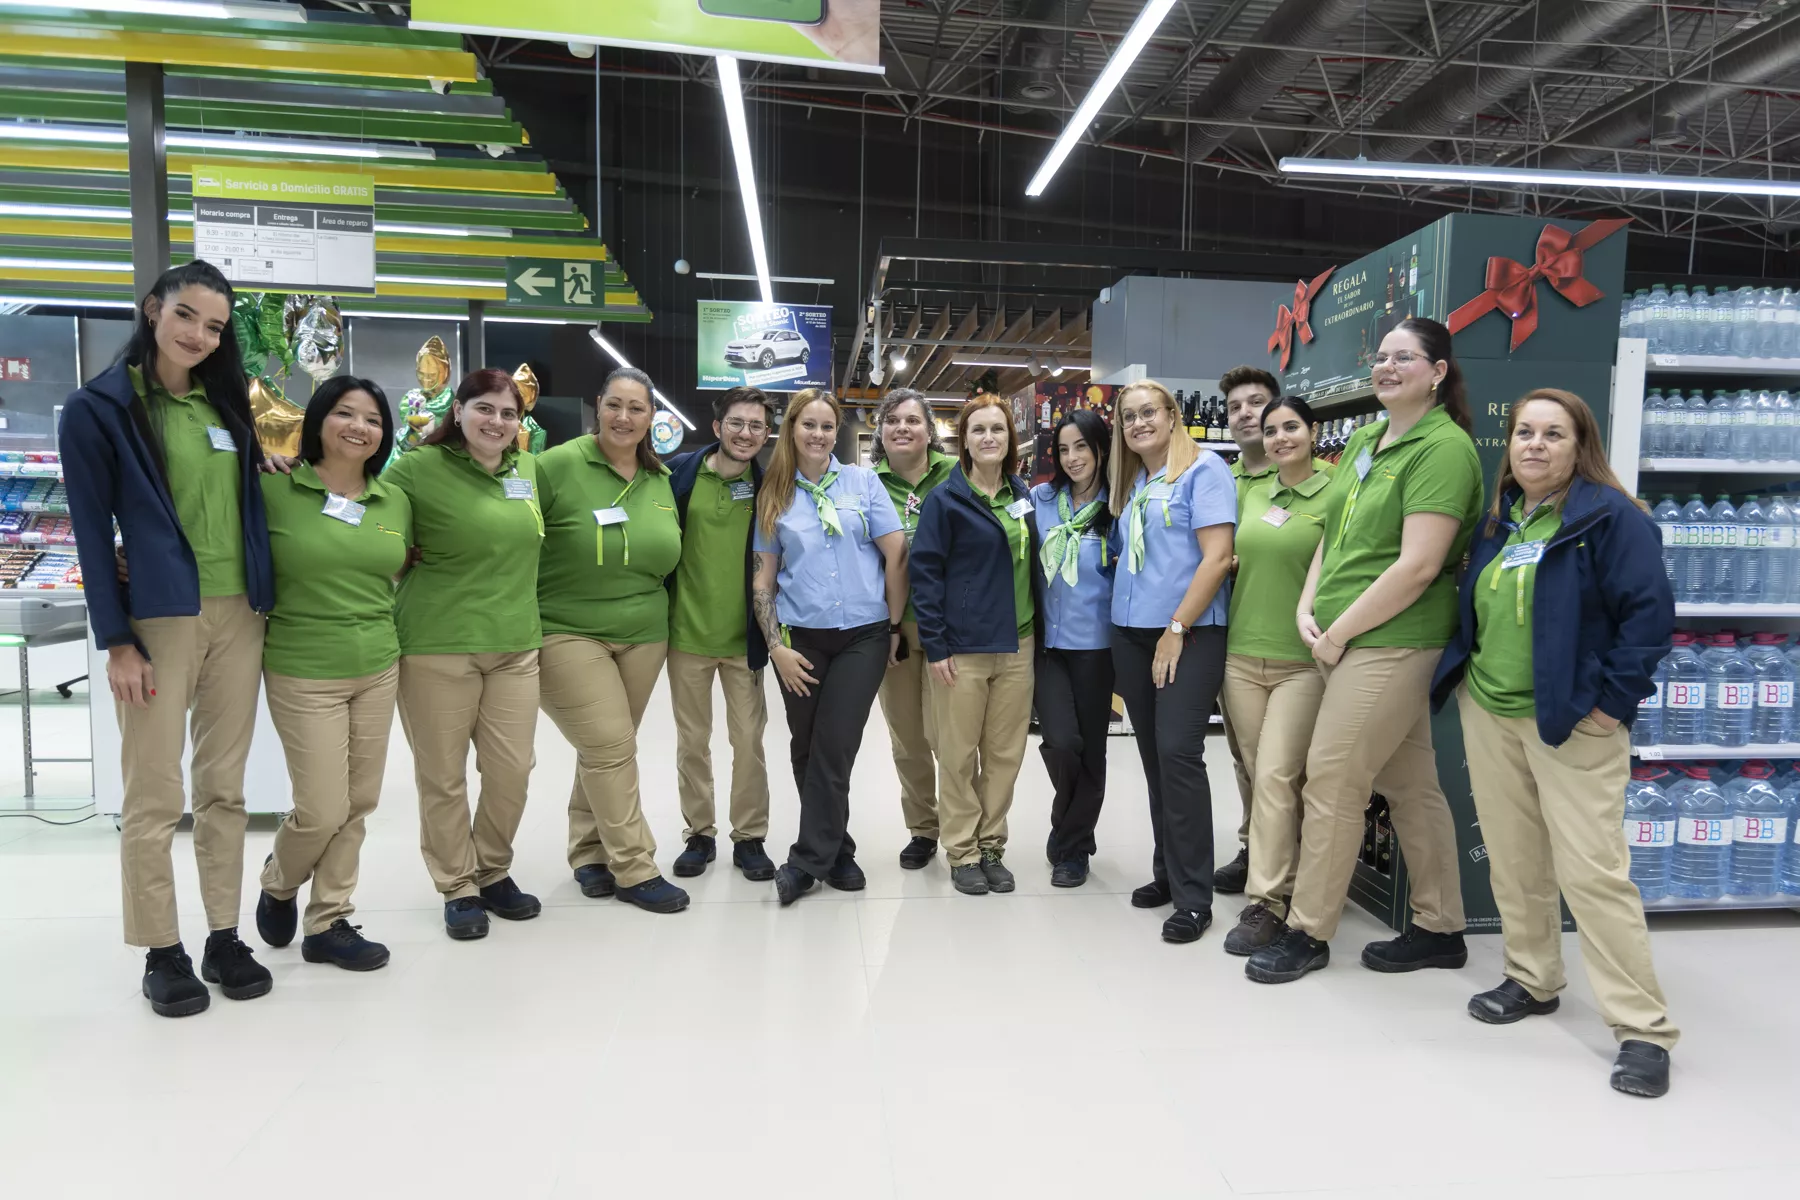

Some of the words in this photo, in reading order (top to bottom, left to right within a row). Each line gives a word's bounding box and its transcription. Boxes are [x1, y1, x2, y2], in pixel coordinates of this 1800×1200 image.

[225, 178, 268, 191] Servicio
[271, 183, 278, 191] a
[281, 181, 331, 194] Domicilio
[333, 185, 368, 197] GRATIS
[200, 208, 225, 217] Horario
[225, 211, 251, 219] compra
[273, 213, 299, 223] Entrega
[322, 216, 336, 225] Área
[337, 218, 345, 226] de
[346, 220, 368, 228] reparto
[1332, 270, 1367, 296] REGALA
[1337, 296, 1343, 304] EL
[1344, 288, 1361, 302] SABOR
[1324, 300, 1374, 327] EXTRAORDINARIO
[702, 375, 740, 383] HiperDino
[1673, 685, 1701, 705] BB
[1724, 686, 1750, 705] BB
[1764, 684, 1790, 704] BB
[1636, 821, 1665, 843] BB
[1692, 819, 1722, 841] BB
[1744, 817, 1775, 839] BB
